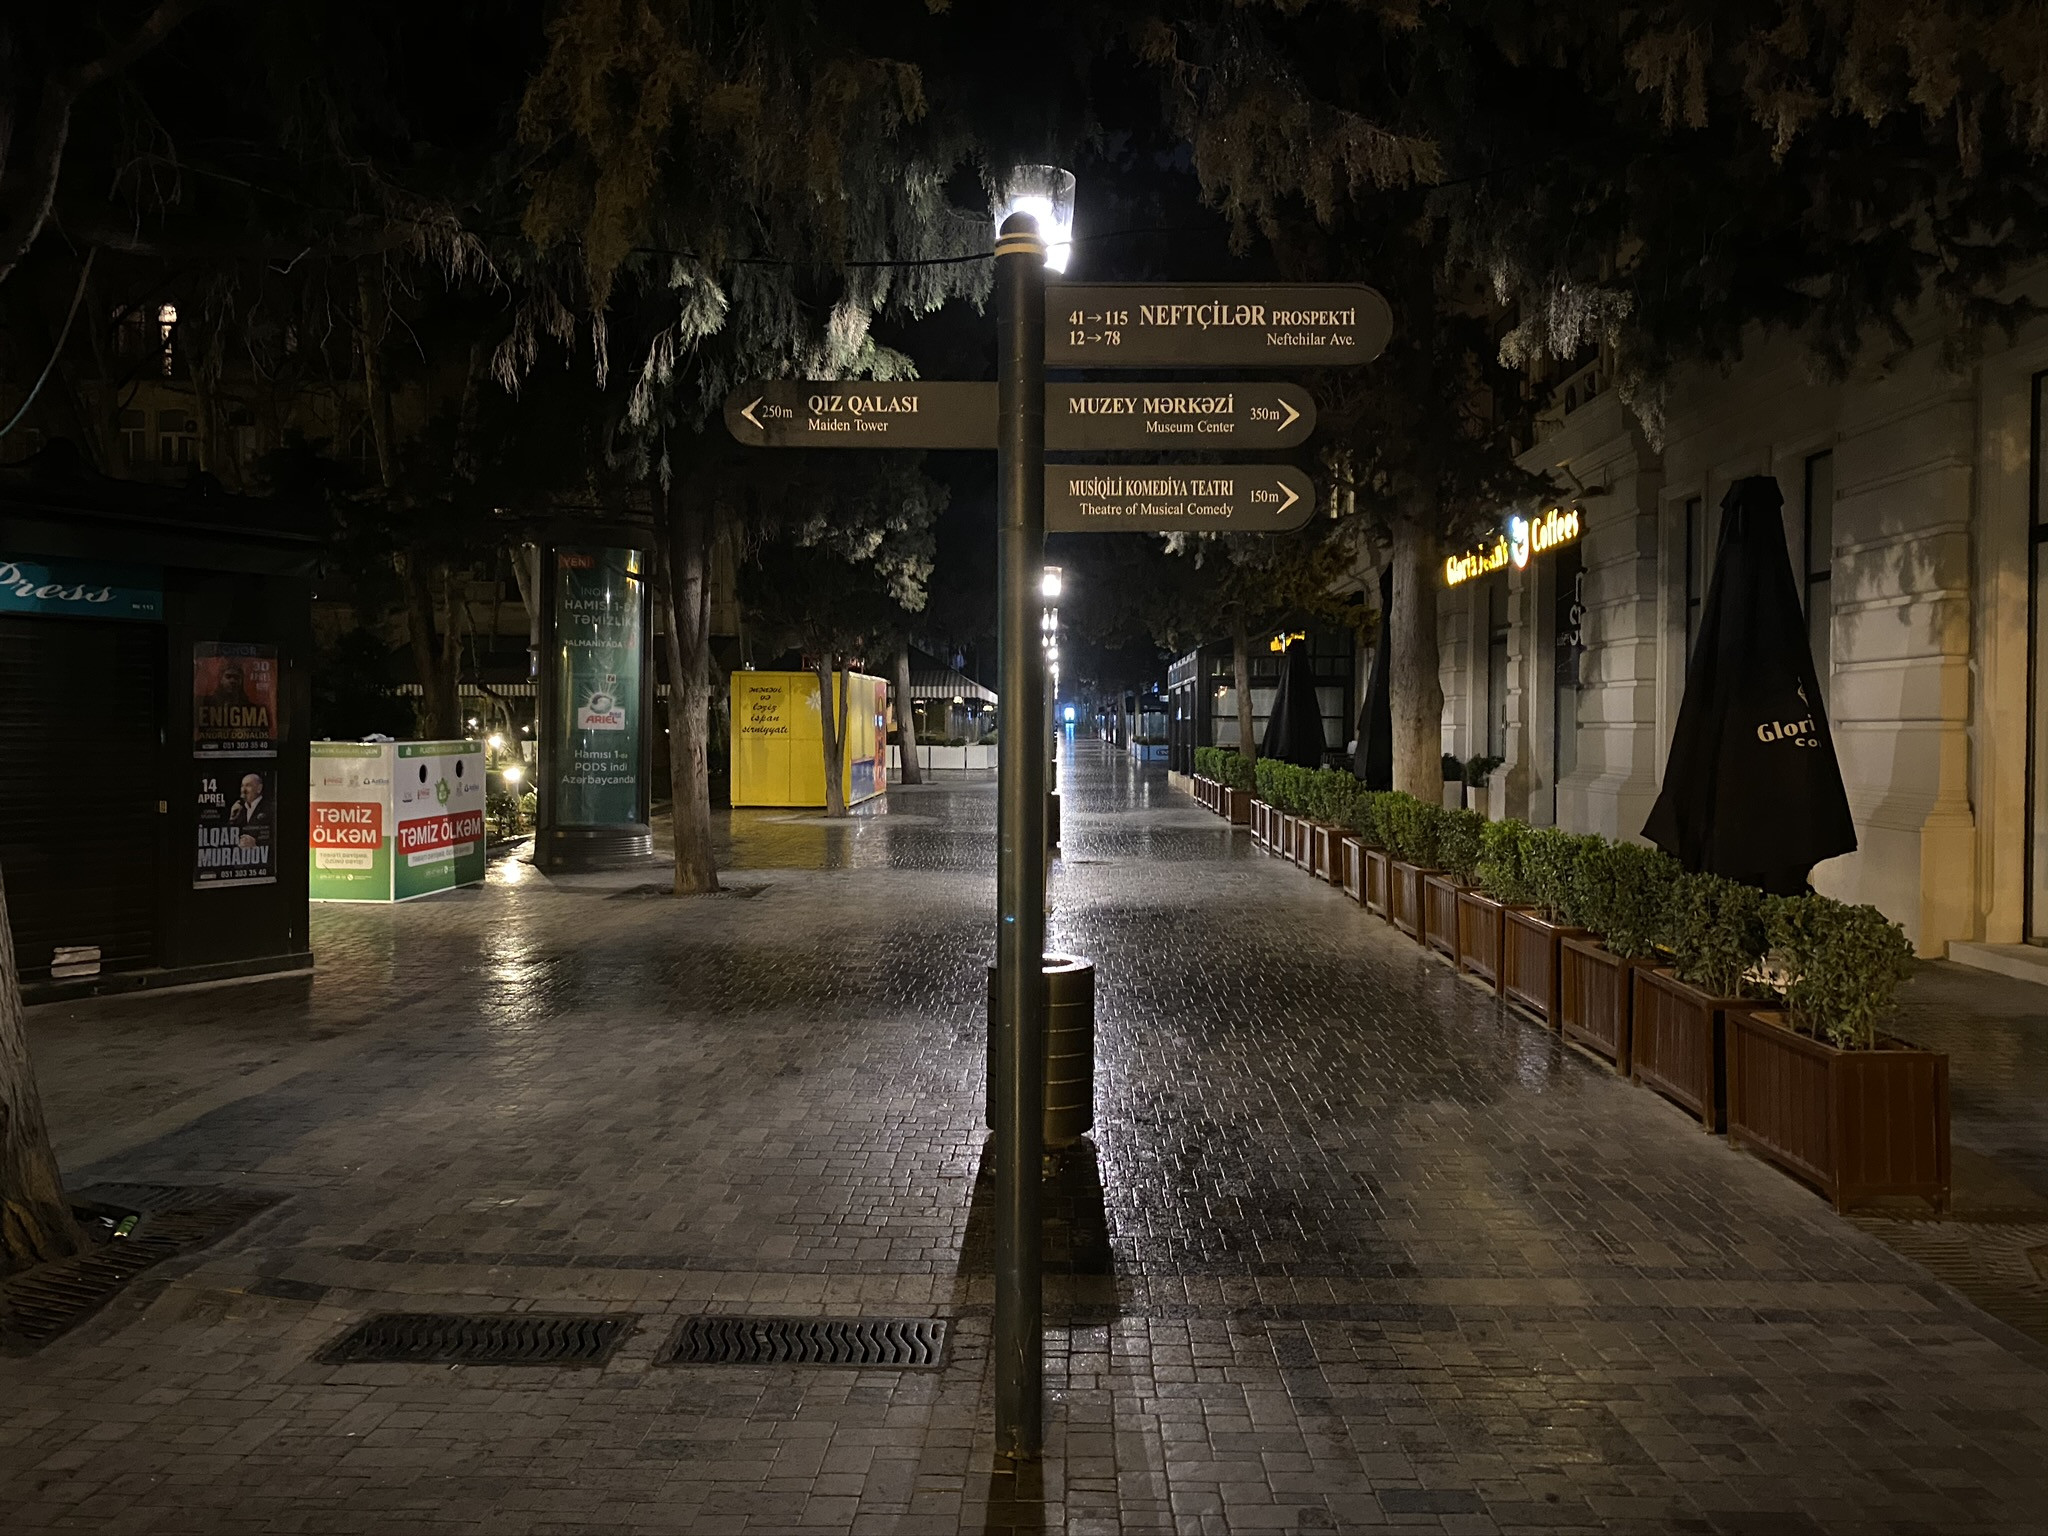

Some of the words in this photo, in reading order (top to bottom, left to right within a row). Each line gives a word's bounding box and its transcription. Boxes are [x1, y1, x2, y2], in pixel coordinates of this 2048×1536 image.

[1069, 310, 1085, 326] 41
[1105, 310, 1129, 326] 115
[1139, 300, 1267, 331] NEFTÇİLƏR
[1272, 307, 1356, 326] PROSPEKTİ
[1070, 330, 1086, 346] 12
[1104, 330, 1121, 346] 78
[1267, 332, 1325, 347] Neftchilar
[1329, 333, 1356, 347] Ave.
[762, 405, 793, 419] 250m
[808, 395, 844, 416] QIZ
[848, 395, 919, 414] QALASI
[1069, 397, 1138, 414] MUZEY
[1143, 393, 1234, 415] MƏRKƏZİ
[1250, 408, 1280, 421] 350m
[808, 418, 851, 431] Maiden
[853, 419, 889, 432] Tower
[1146, 420, 1194, 433] Museum
[1197, 420, 1235, 433] Center
[1069, 476, 1122, 500] MUSİQİLİ
[1125, 476, 1189, 496] KOMEDİYA
[1190, 480, 1234, 496] TEATRI
[1250, 490, 1280, 503] 150m
[1080, 502, 1122, 515] Theatre
[1125, 502, 1139, 515] of
[1140, 502, 1184, 515] Musical
[1187, 502, 1234, 518] Comedy
[1446, 549, 1477, 586] Gloria
[1532, 508, 1579, 552] Coffees
[586, 715, 618, 724] ARIEL
[575, 762, 607, 772] PODS
[610, 762, 627, 771] indi
[202, 778, 218, 793] 14
[197, 793, 226, 804] APREL
[317, 806, 372, 823] TƏMİZ
[198, 824, 240, 848] İLQAR
[312, 825, 377, 844] ÖLKƏM
[400, 821, 438, 848] TƏMİZ
[440, 817, 481, 840] ÖLKƏM
[197, 845, 269, 868] MURADOV
